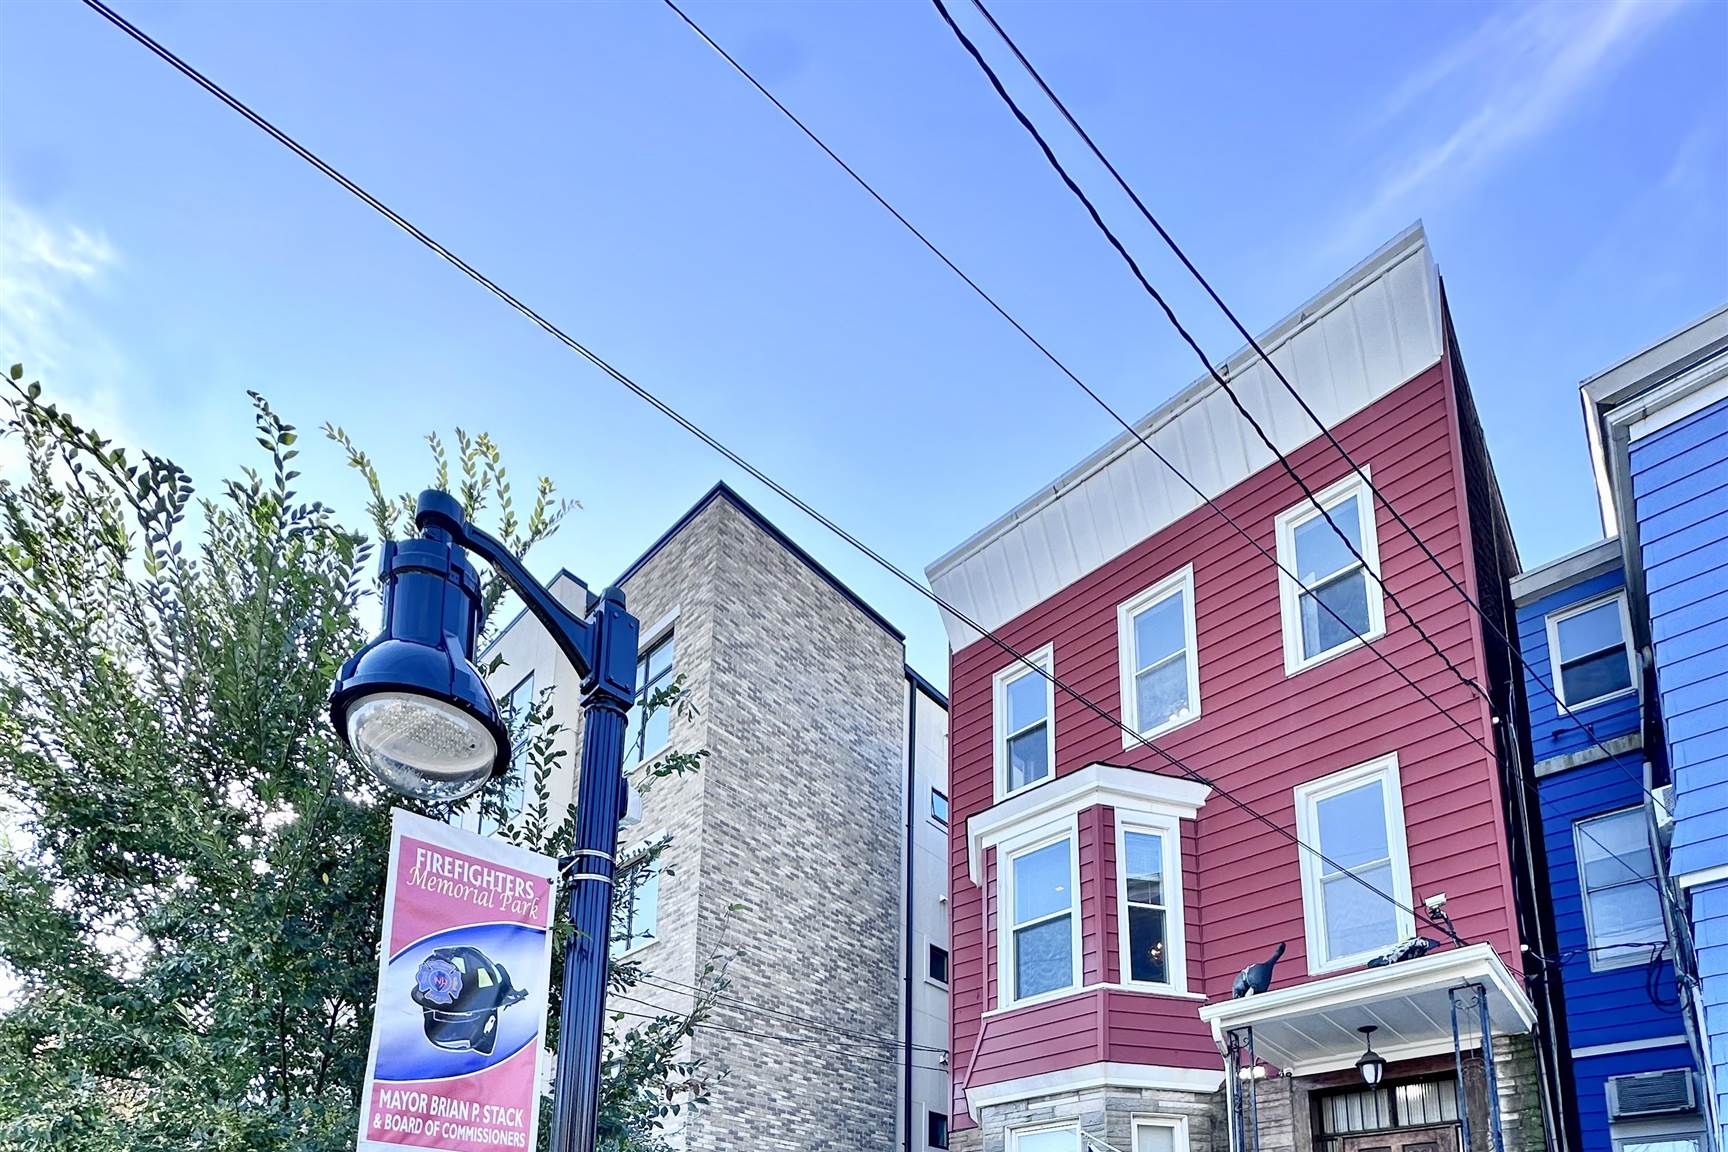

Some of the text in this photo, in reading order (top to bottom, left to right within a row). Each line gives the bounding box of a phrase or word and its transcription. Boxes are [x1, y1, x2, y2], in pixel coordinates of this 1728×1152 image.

[406, 865, 540, 919] Memorial Park
[416, 847, 535, 899] FIREFIGHTERS
[373, 1112, 526, 1147] & BOARD OF COMMISSIONERS
[379, 1088, 524, 1128] MAYOR BRIAN P. STACK
